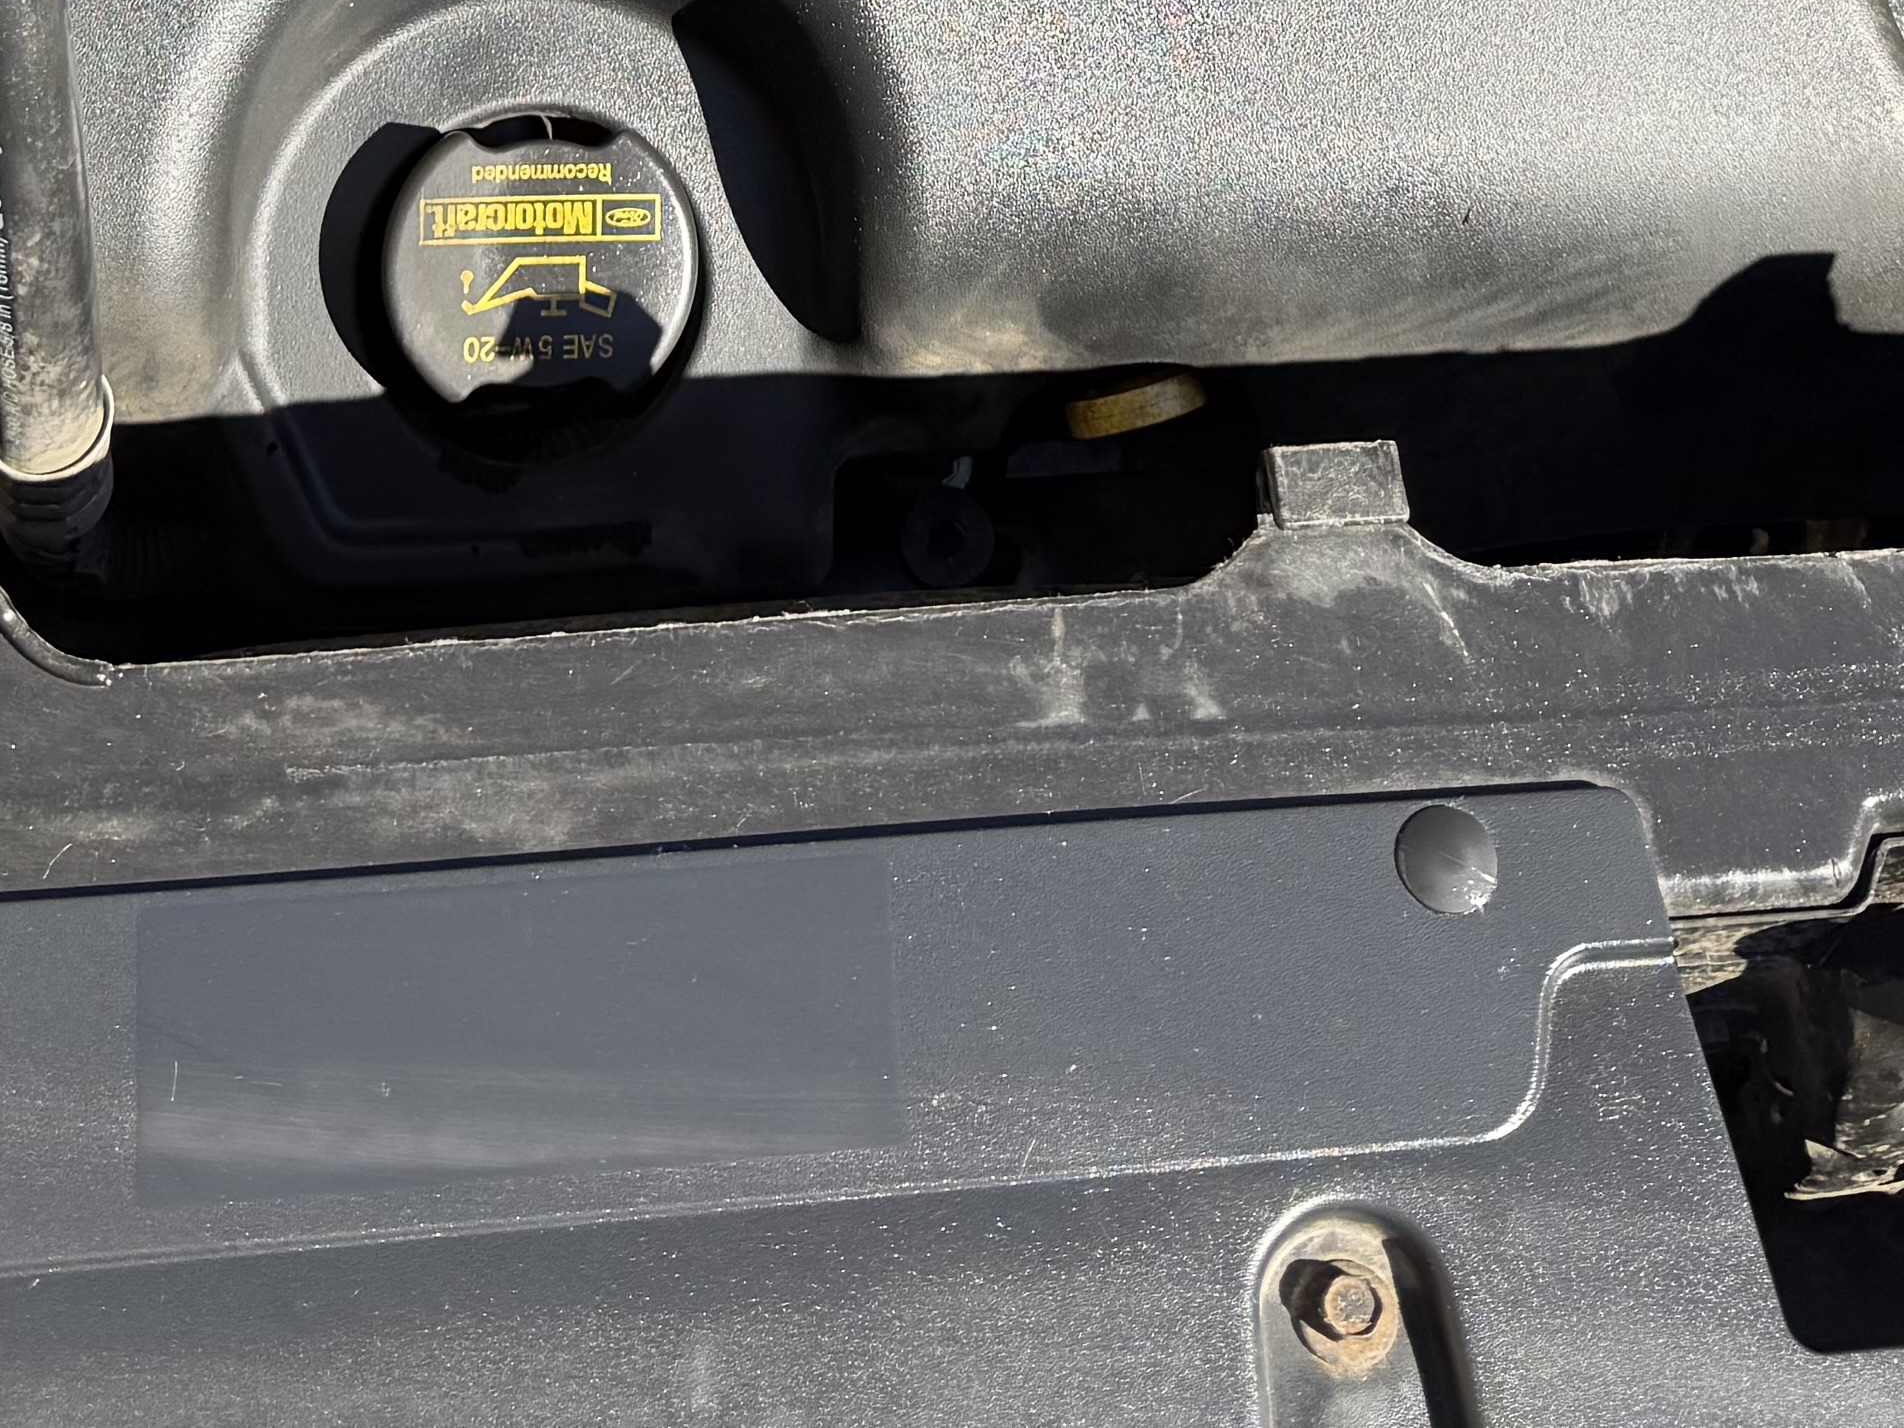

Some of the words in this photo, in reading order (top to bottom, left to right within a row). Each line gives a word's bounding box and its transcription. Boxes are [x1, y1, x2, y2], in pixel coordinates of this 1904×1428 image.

[472, 162, 612, 184] Recommended
[426, 200, 593, 239] Motorcraft
[562, 334, 614, 361] SAE
